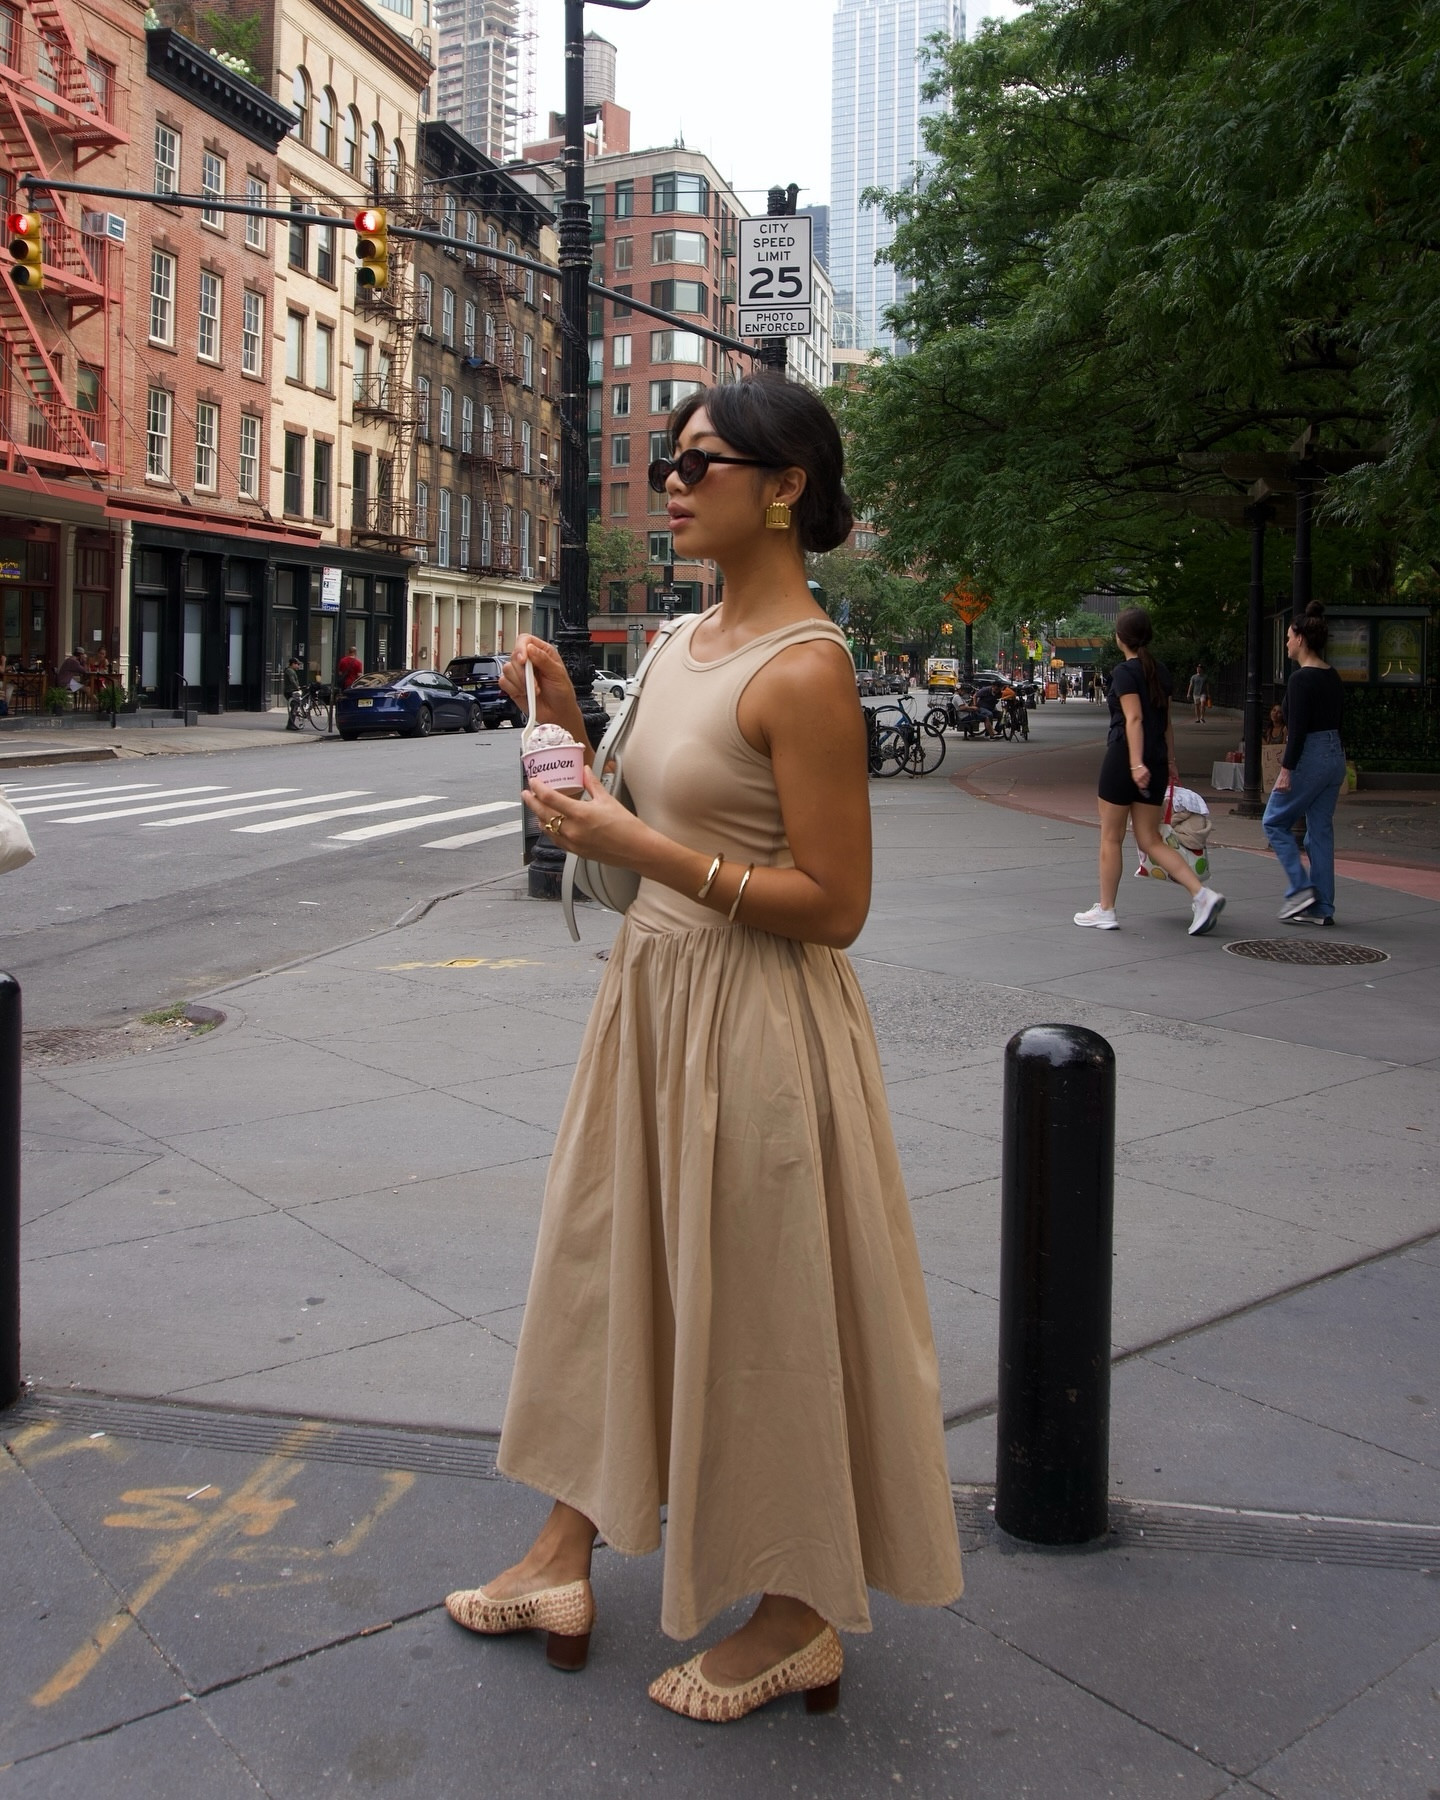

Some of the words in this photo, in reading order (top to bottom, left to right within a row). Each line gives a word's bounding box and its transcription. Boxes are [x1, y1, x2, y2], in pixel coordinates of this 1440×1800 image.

[759, 223, 789, 234] CITY
[753, 237, 795, 248] SPEED
[757, 251, 791, 262] LIMIT
[748, 266, 803, 299] 25
[756, 312, 794, 322] PHOTO
[745, 322, 805, 333] ENFORCED
[528, 758, 574, 778] Leeuwen
